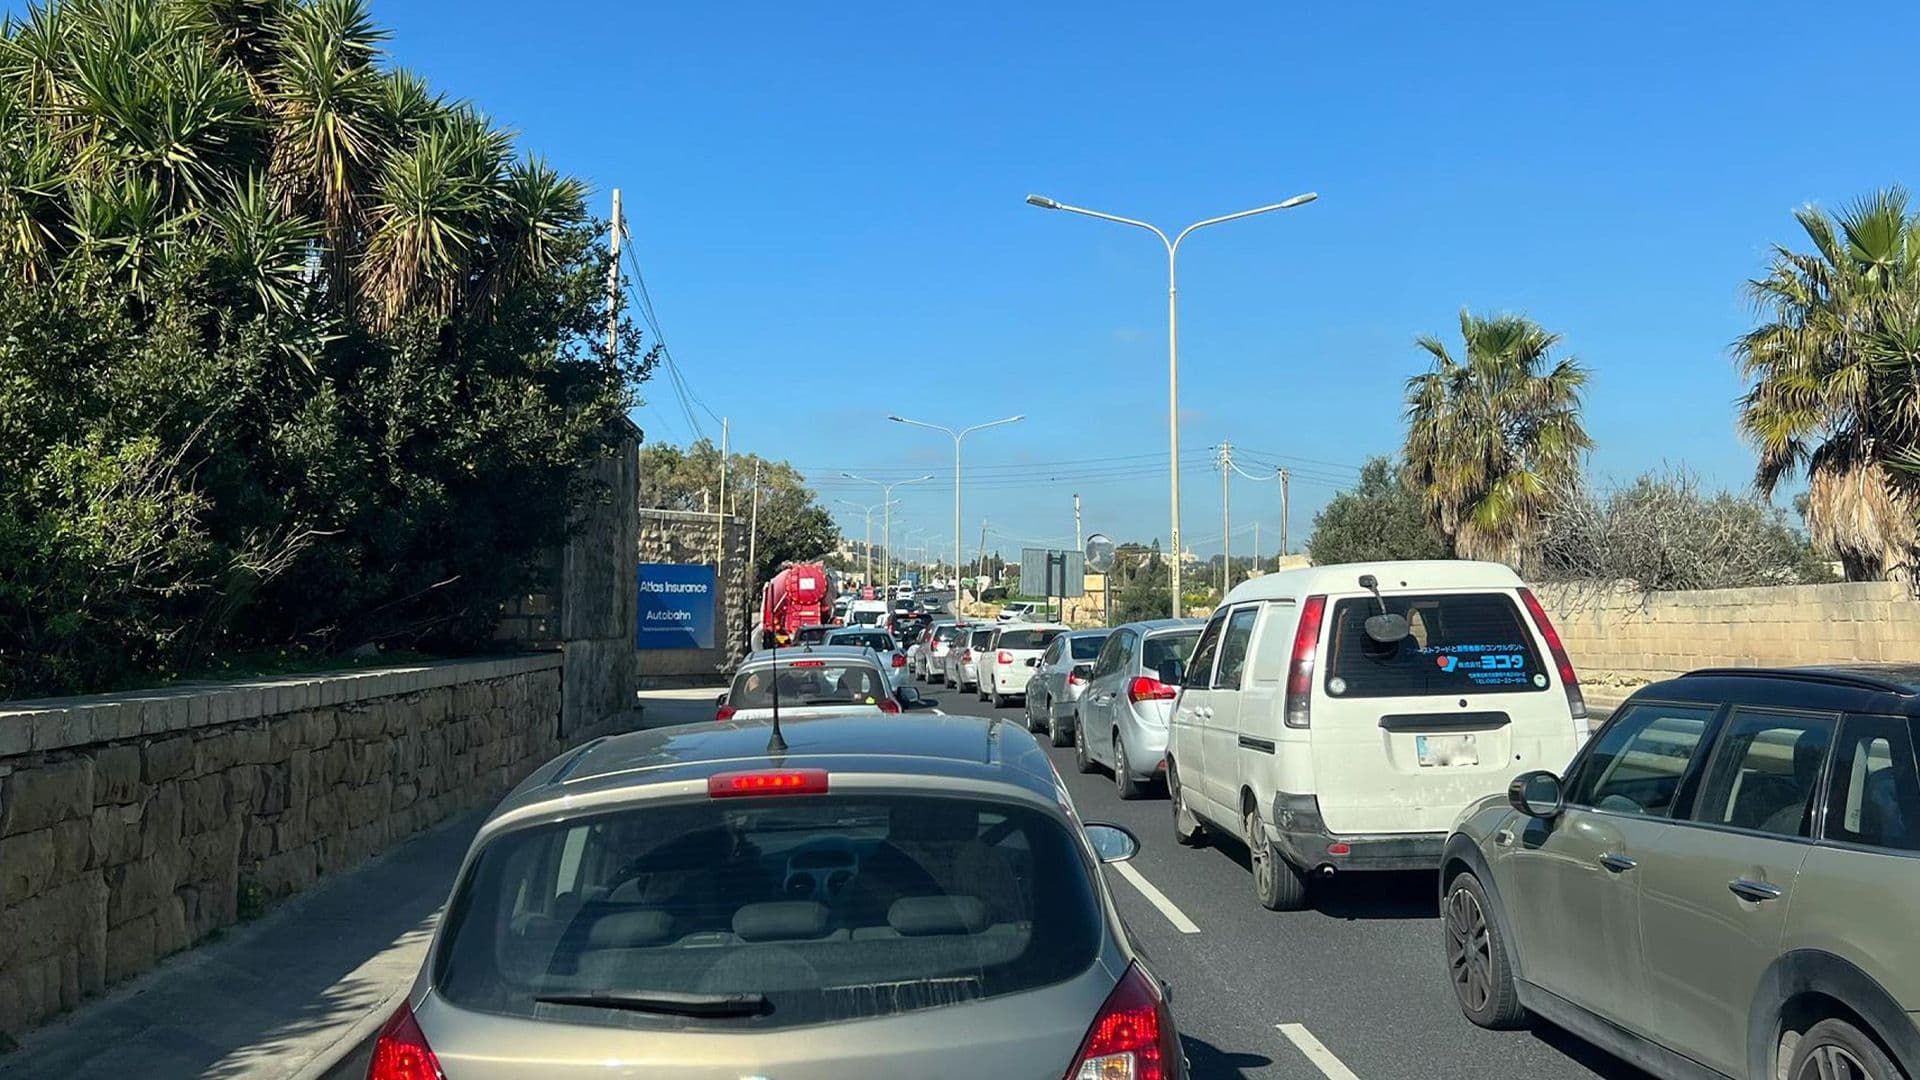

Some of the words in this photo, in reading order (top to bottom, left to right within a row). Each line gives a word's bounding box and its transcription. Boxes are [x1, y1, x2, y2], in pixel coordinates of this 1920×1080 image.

[640, 581, 664, 592] Atlas
[665, 581, 708, 593] Insurance
[646, 610, 691, 620] Autobahn
